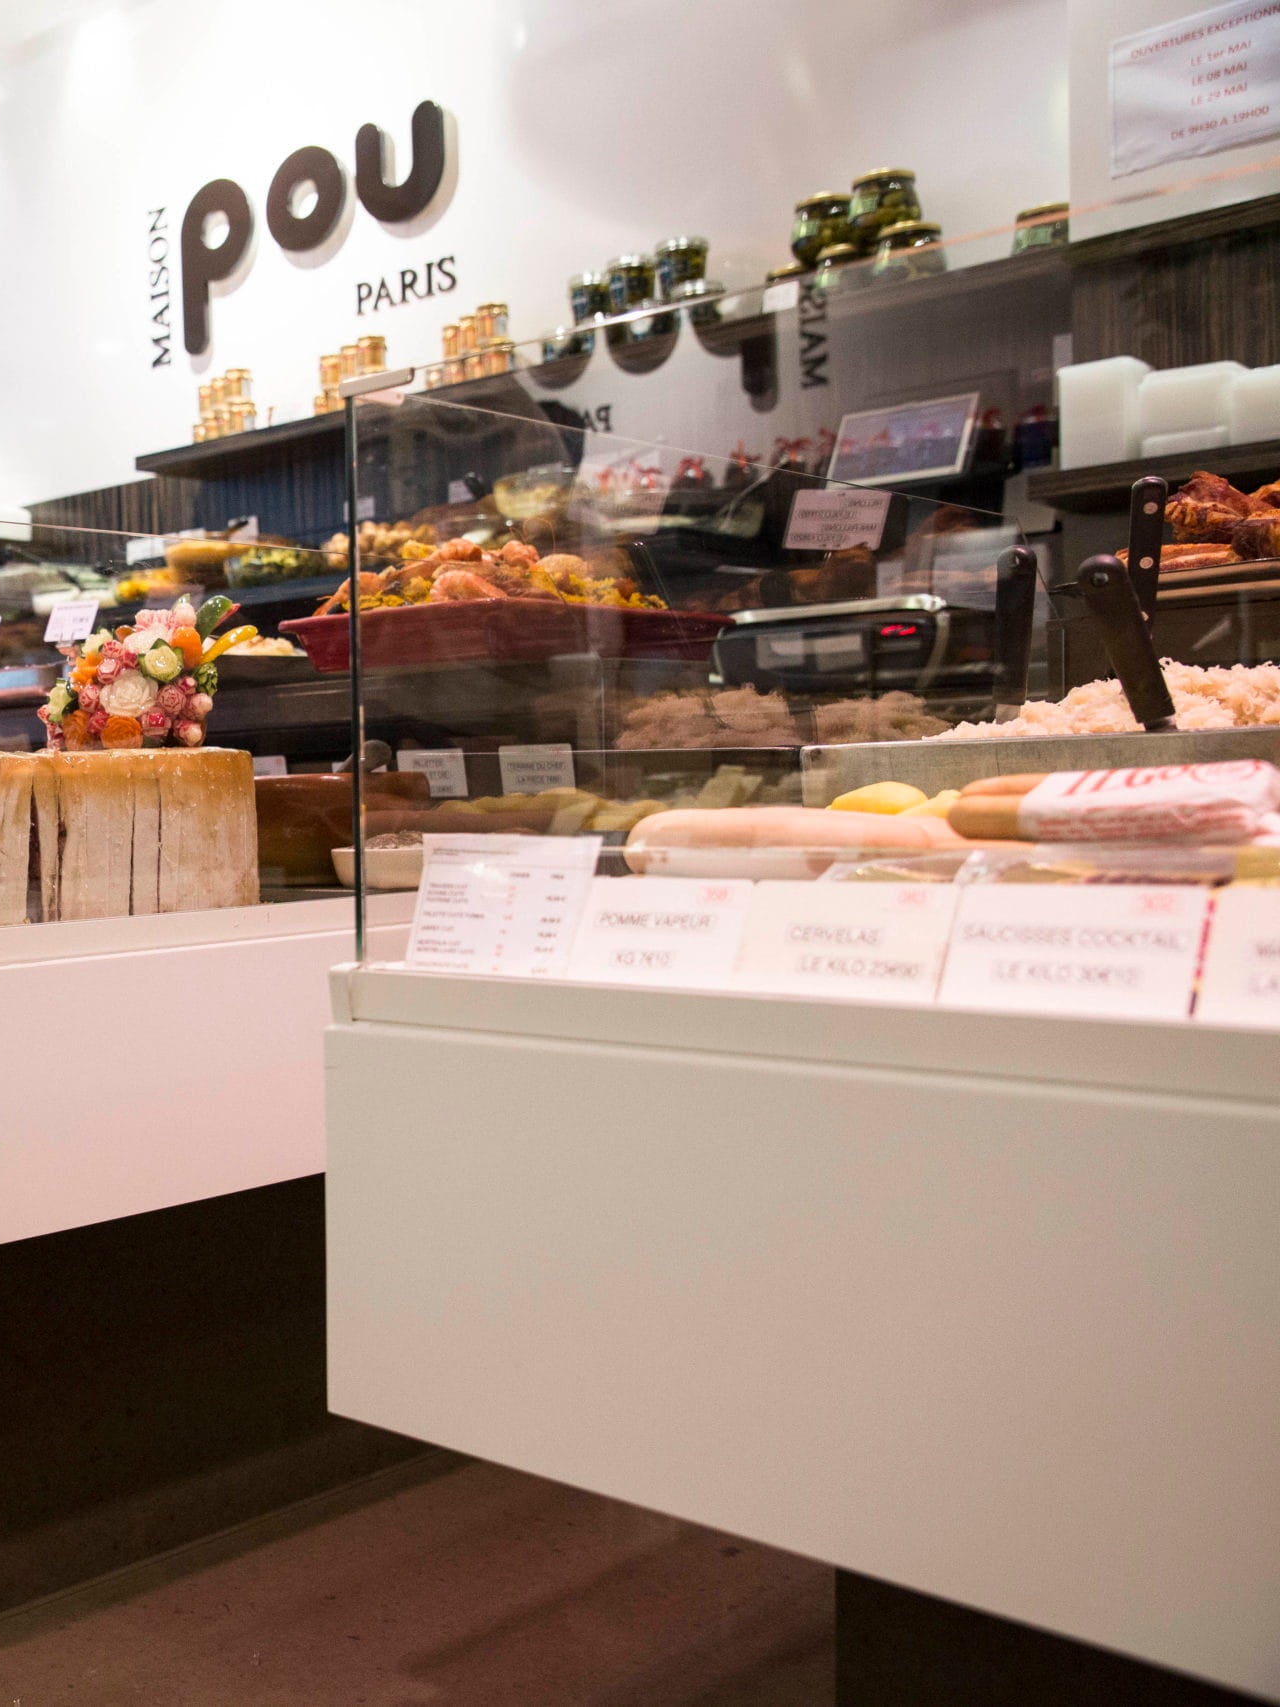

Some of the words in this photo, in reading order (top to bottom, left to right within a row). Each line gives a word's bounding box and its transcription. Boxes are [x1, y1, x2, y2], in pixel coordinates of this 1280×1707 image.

[1131, 29, 1205, 59] OUVERTURES
[1191, 56, 1202, 67] LE
[1228, 40, 1252, 55] MAI
[1192, 74, 1203, 86] LE
[1223, 62, 1248, 77] MAI
[1191, 95, 1202, 106] LE
[1223, 83, 1248, 97] MAI
[1171, 129, 1184, 140] DE
[147, 206, 172, 369] MAISON
[356, 256, 458, 316] PARIS
[600, 912, 650, 927] POMME
[654, 913, 712, 928] VAPEUR
[790, 926, 880, 945] CERVELAS
[963, 923, 1071, 944] SAUCISSES
[1077, 928, 1188, 951] COCKTAIL
[800, 956, 820, 972] LE
[827, 958, 865, 976] KILO
[997, 961, 1019, 979] LE
[1027, 963, 1071, 982] KILO
